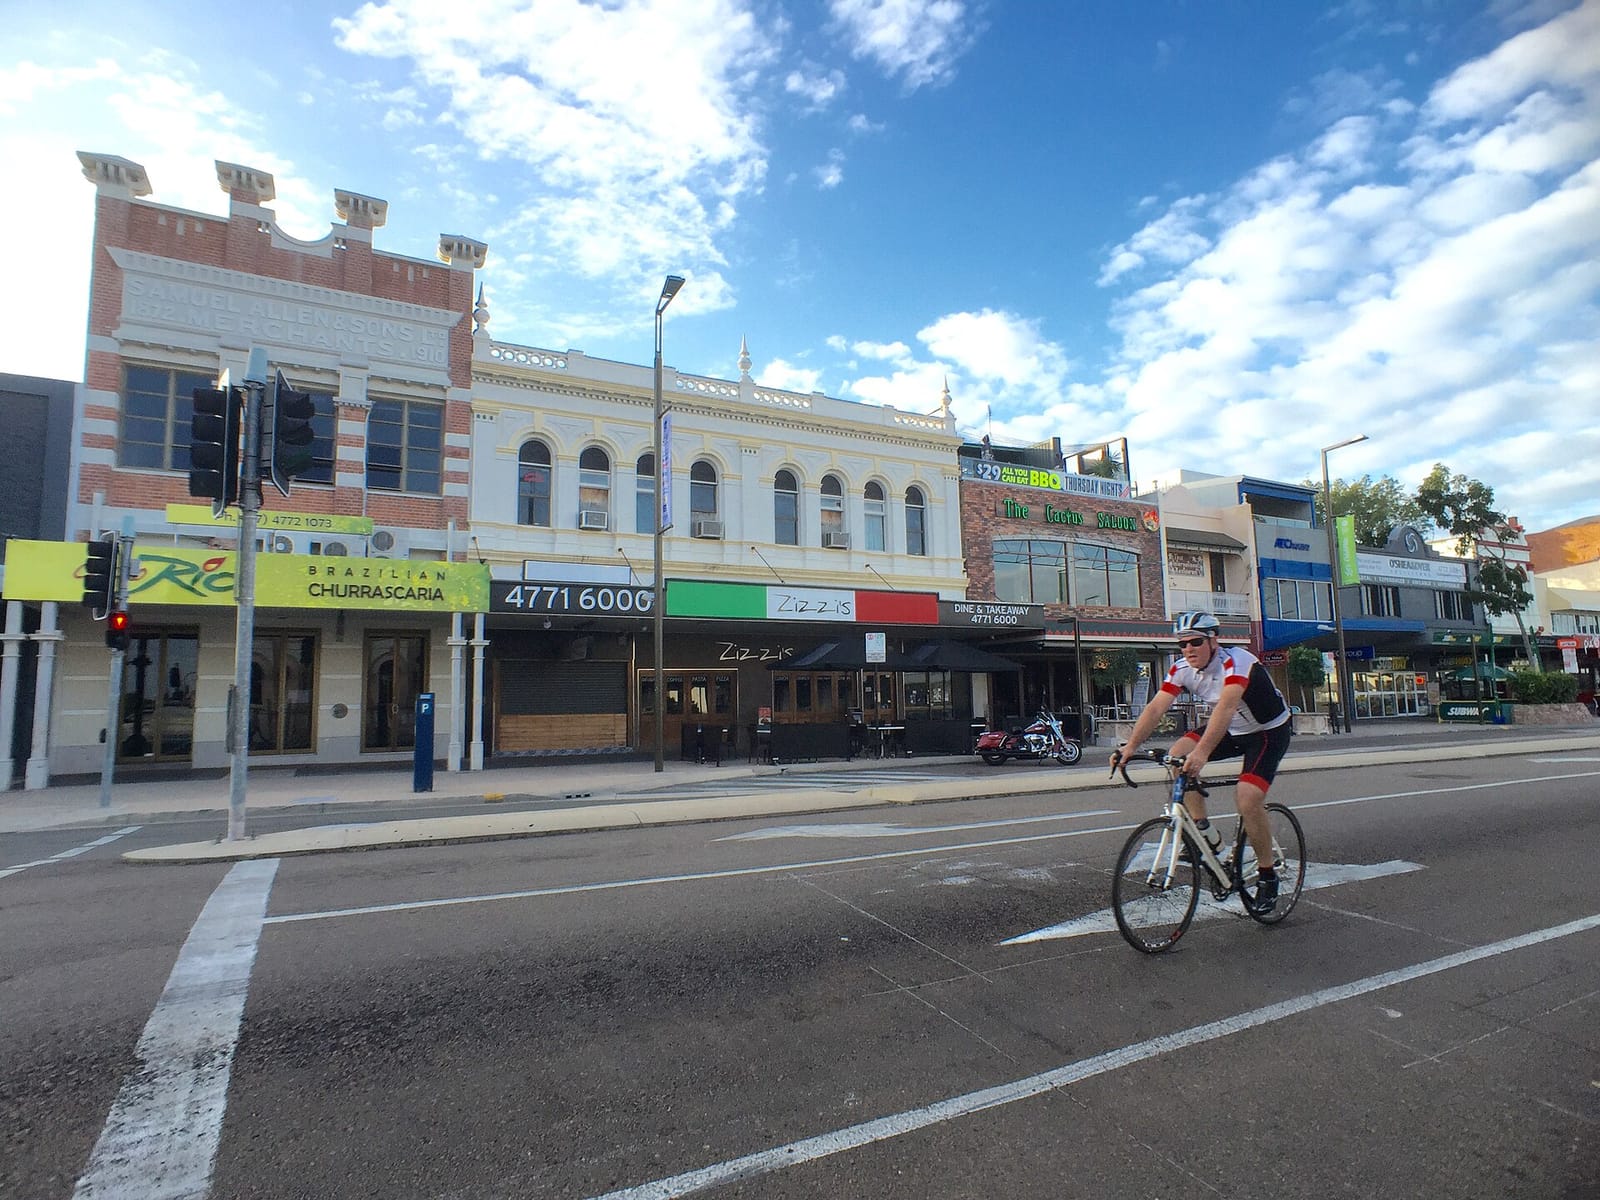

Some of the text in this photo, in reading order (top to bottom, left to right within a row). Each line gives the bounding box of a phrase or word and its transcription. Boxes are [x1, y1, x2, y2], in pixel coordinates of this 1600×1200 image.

[126, 279, 240, 314] SAMUEL
[130, 302, 175, 321] 1872
[410, 346, 447, 363] 1910
[975, 463, 1001, 481] $29
[1002, 467, 1027, 477] ALL YOU
[1002, 475, 1029, 485] CAN EAT
[1029, 470, 1062, 490] BBQ
[1065, 476, 1098, 494] THURSDAY
[1003, 498, 1029, 519] The
[1045, 503, 1084, 525] Cactus
[272, 516, 301, 526] 4772
[305, 518, 332, 528] 1073
[308, 565, 446, 580] BRAZILIAN
[308, 583, 444, 601] CHURRASCARIA
[505, 585, 653, 612] 4771 6000
[954, 603, 1029, 615] DINE & TAKEAWAY
[971, 615, 1017, 625] 4771 6000
[422, 703, 429, 713] P
